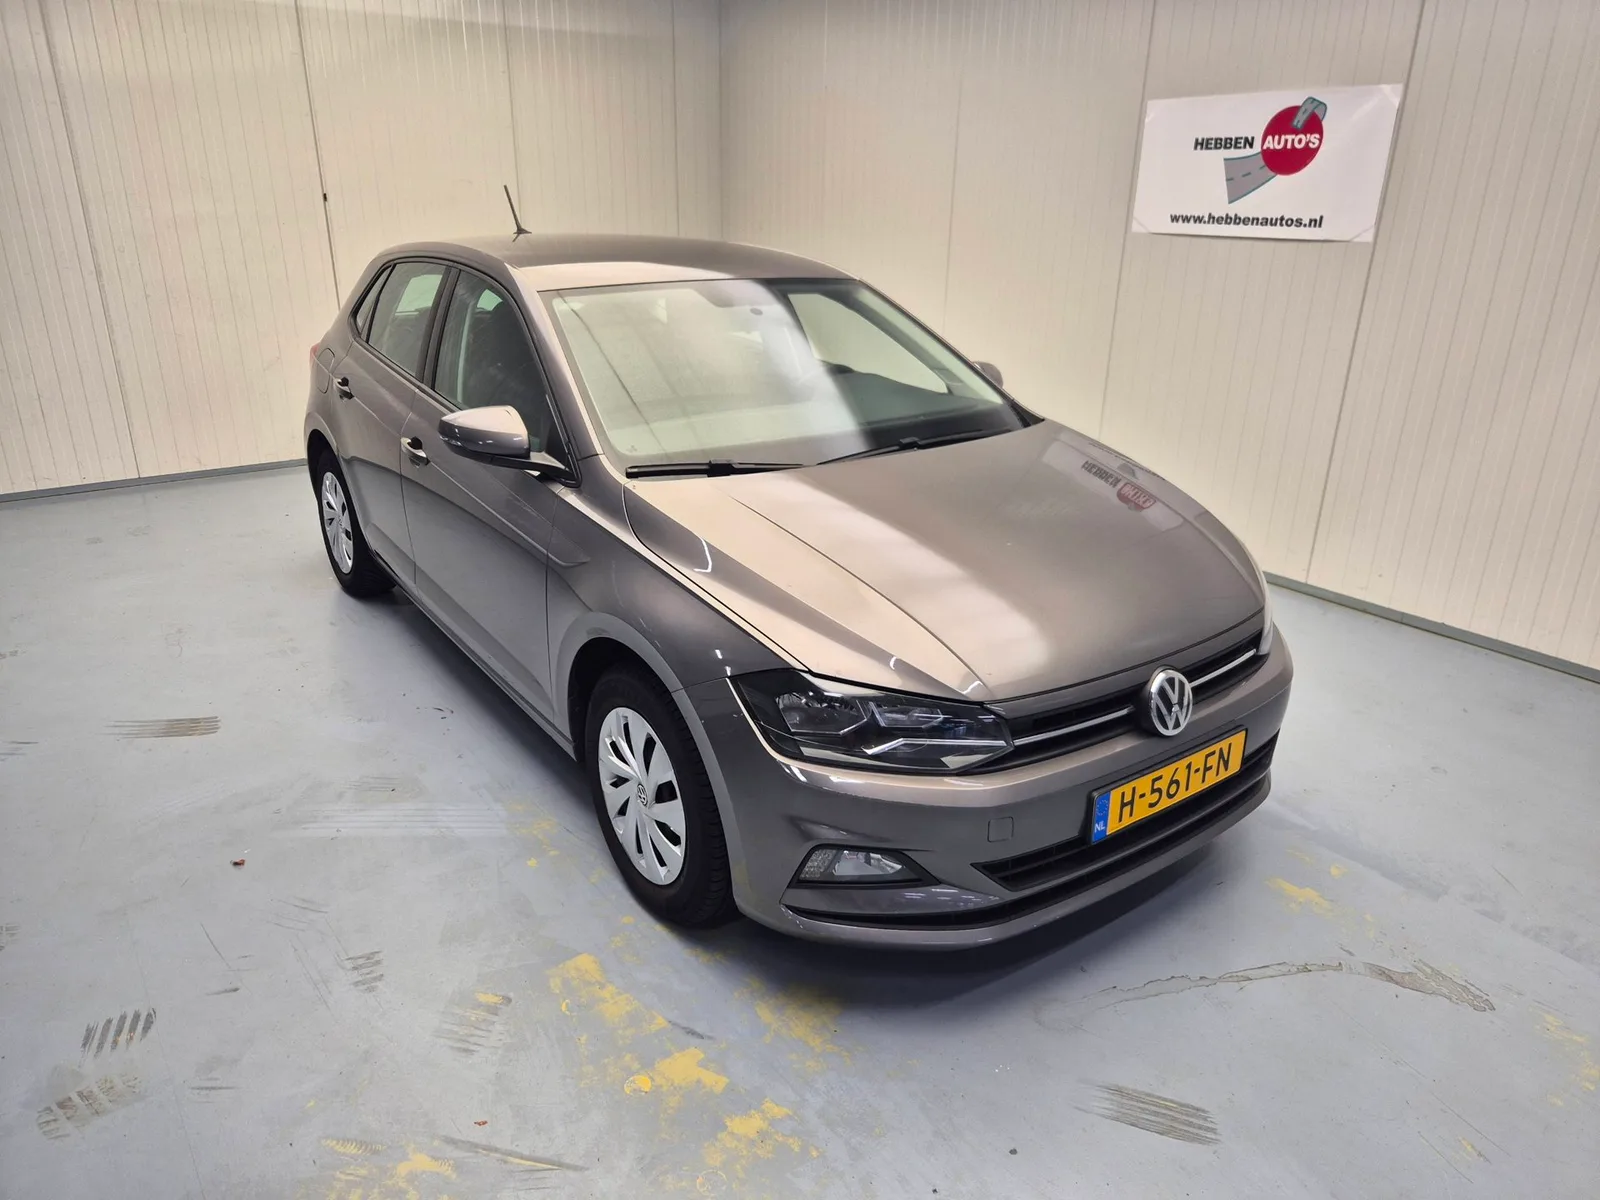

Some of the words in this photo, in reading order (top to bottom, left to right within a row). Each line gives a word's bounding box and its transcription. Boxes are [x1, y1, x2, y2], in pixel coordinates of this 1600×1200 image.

[1194, 136, 1255, 150] HEBBEN
[1263, 133, 1321, 150] AUTO'S
[1169, 213, 1324, 229] www.hebbenautos.nl
[1118, 743, 1232, 823] H-561-FN
[1094, 821, 1106, 833] NL
